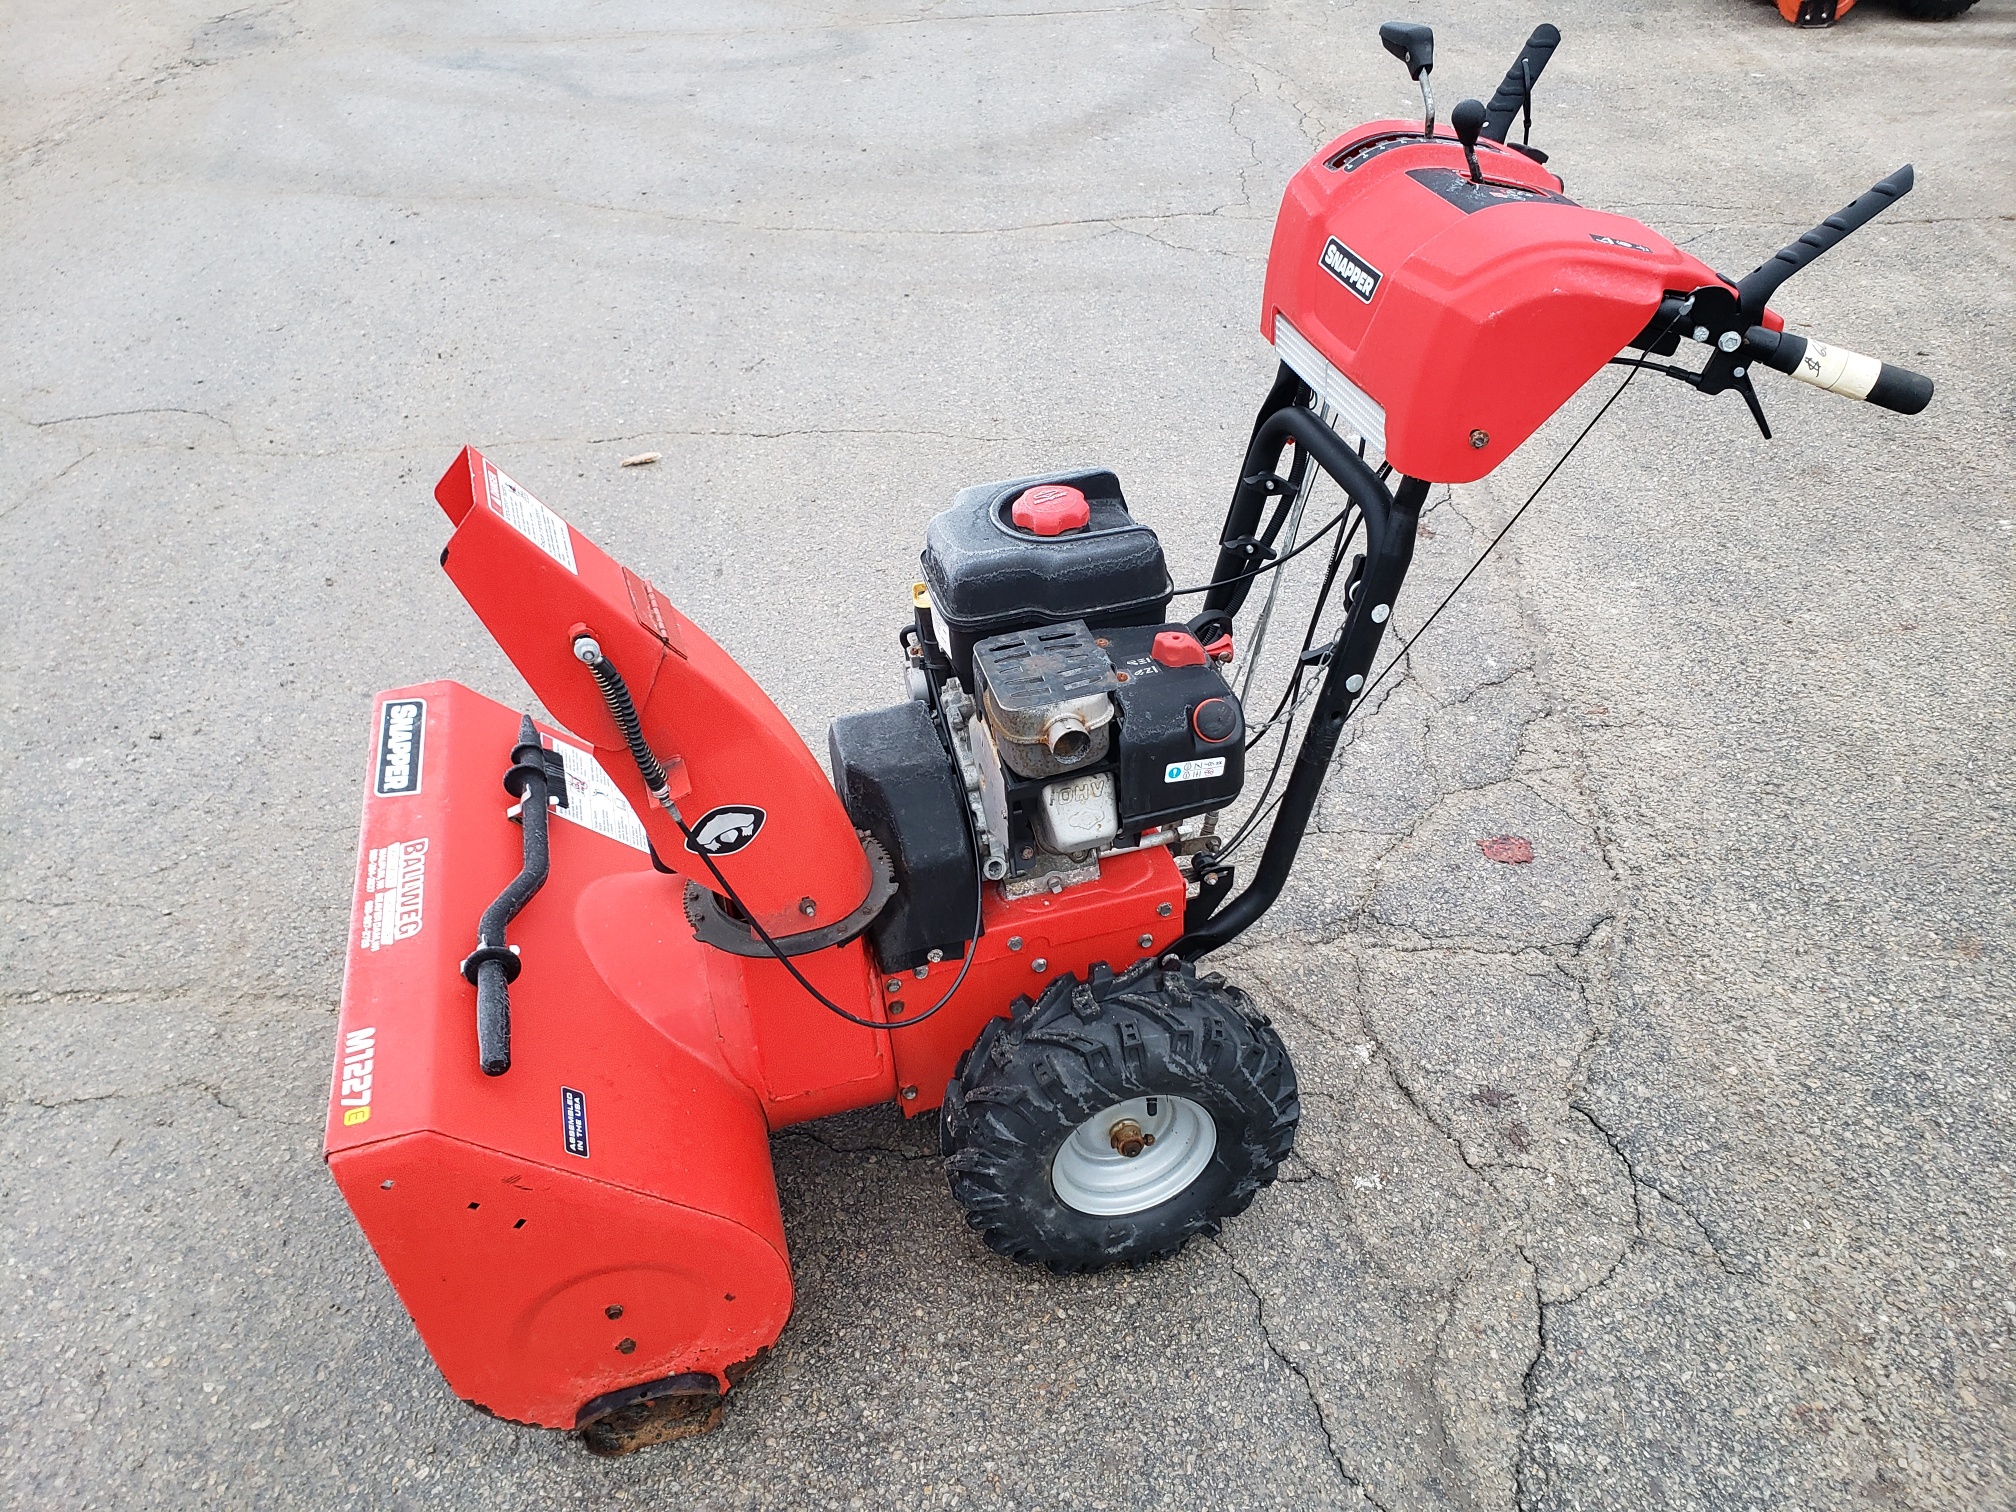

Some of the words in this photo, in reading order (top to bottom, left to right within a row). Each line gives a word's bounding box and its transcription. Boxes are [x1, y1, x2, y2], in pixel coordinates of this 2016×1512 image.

[1324, 243, 1375, 297] SNAPPER
[383, 703, 419, 793] SNAPPER
[1057, 779, 1105, 806] OHV
[398, 839, 428, 938] BALLWEG
[566, 1091, 577, 1152] ASSEMBLED
[573, 1097, 582, 1117] USA
[575, 1118, 583, 1138] THE
[576, 1140, 584, 1152] IN
